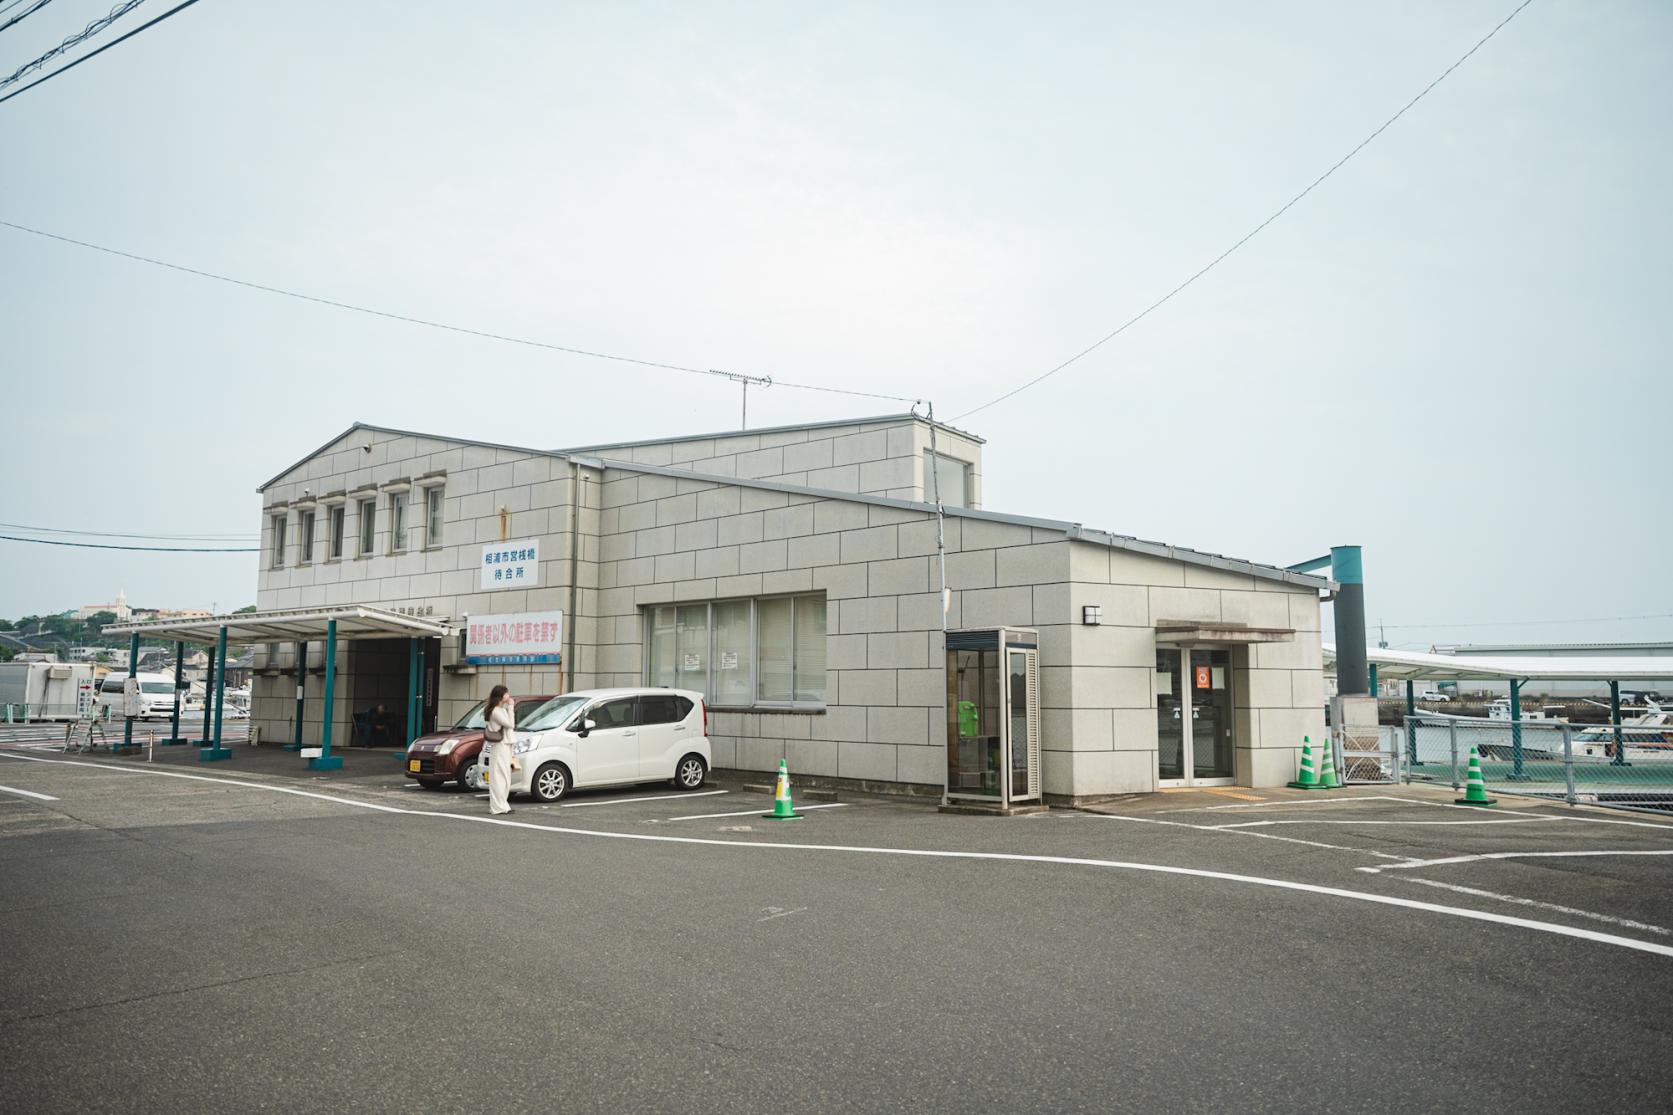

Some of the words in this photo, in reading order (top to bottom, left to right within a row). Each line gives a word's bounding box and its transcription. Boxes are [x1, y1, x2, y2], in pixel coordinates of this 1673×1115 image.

[485, 548, 535, 565] 相浦市営桟橋
[494, 567, 524, 580] 待合所
